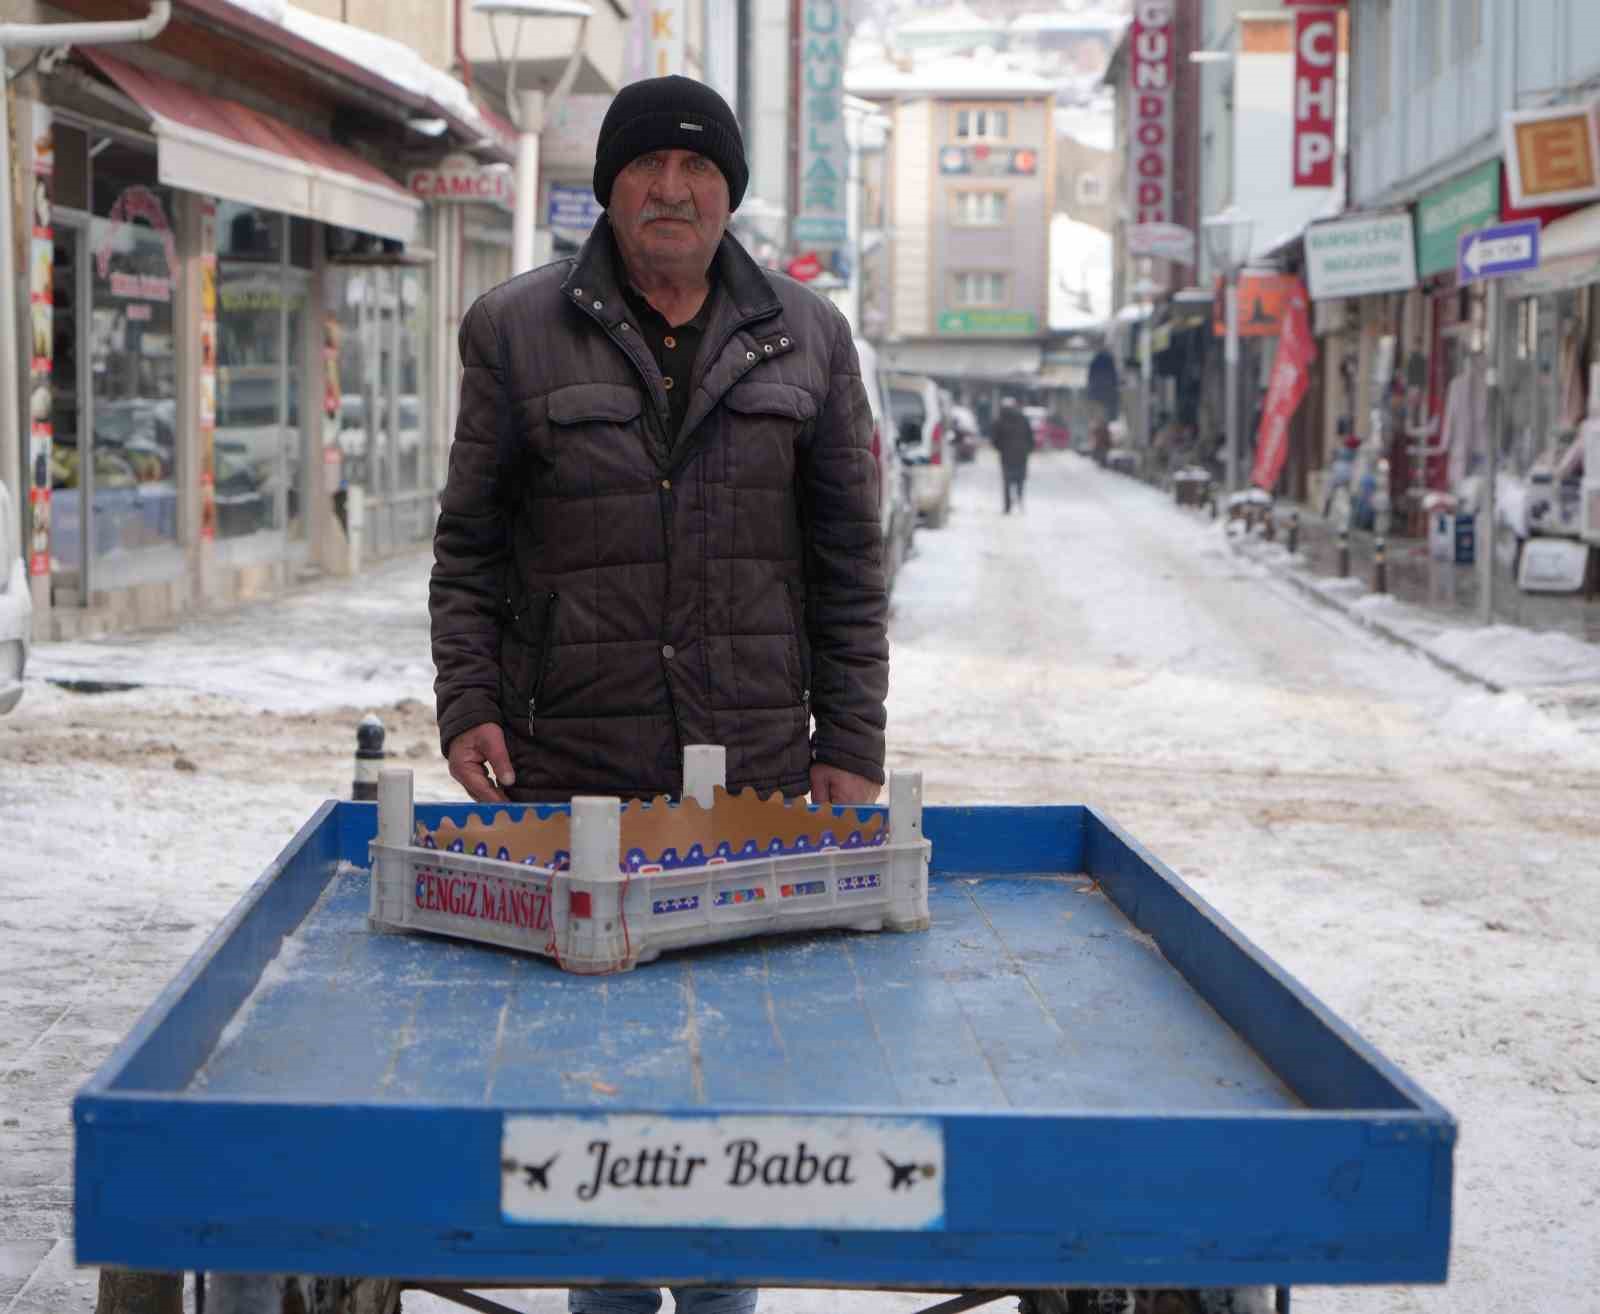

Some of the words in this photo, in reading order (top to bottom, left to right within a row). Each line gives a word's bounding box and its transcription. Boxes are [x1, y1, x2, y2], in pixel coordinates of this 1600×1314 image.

[1298, 21, 1333, 176] CHP
[575, 1139, 708, 1201] Jettir
[724, 1138, 855, 1188] Baba
